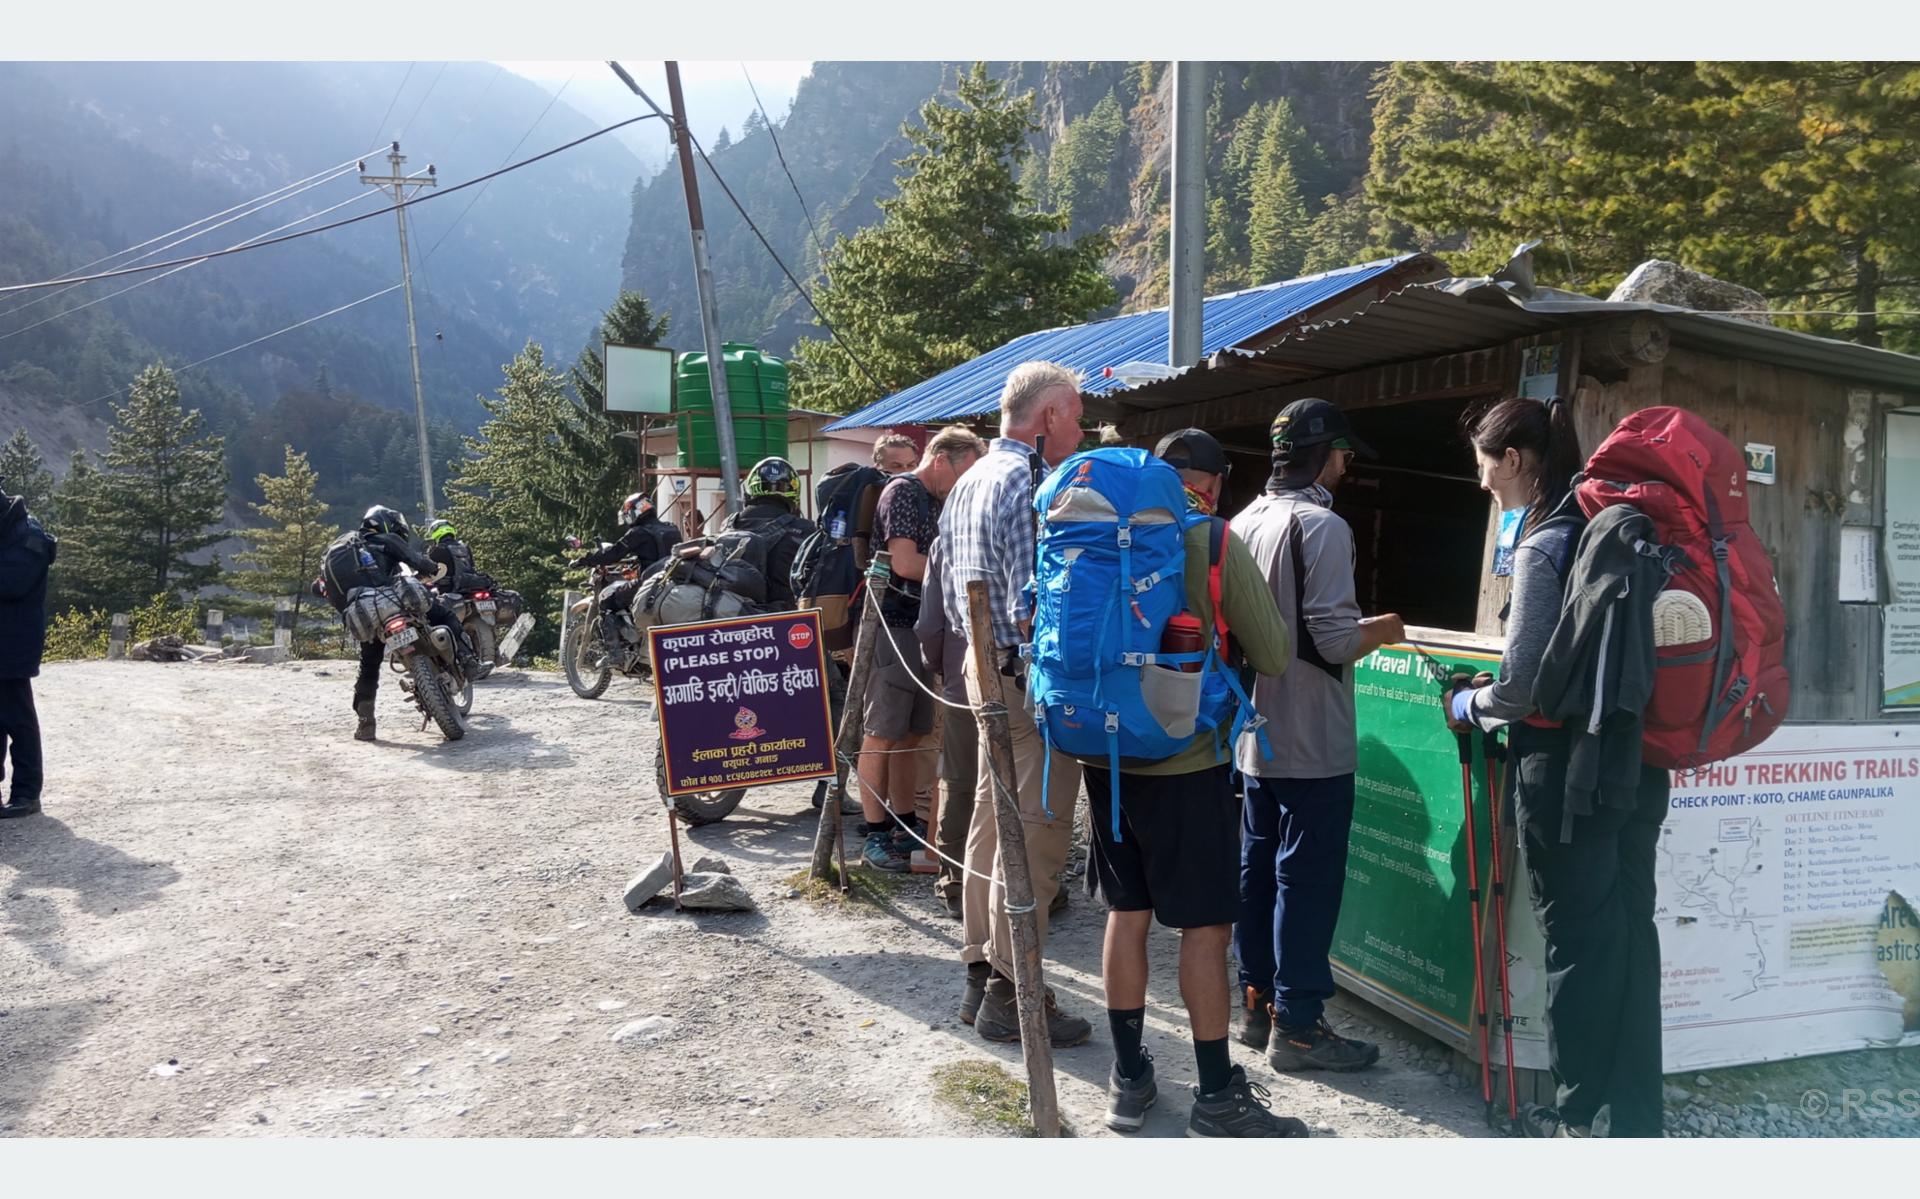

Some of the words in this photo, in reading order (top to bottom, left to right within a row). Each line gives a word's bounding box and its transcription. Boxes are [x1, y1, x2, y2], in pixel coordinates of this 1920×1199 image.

[790, 633, 810, 641] STOP
[664, 656, 729, 673] (PLEASE
[733, 646, 779, 662] STOP)
[1370, 650, 1411, 676] Traval
[1695, 765, 1738, 788] PHU
[1744, 760, 1847, 786] TREKKING
[1853, 757, 1919, 780] TRAILS
[1671, 795, 1708, 809] CHECK
[1711, 793, 1746, 807] POINT
[1753, 791, 1784, 805] KOTO,
[1788, 789, 1826, 803] CHAME
[1828, 786, 1894, 801] GAUNPALIKA
[1785, 811, 1831, 823] OUTLINE
[1834, 808, 1884, 821] ITINERARY
[1877, 939, 1920, 961] astics
